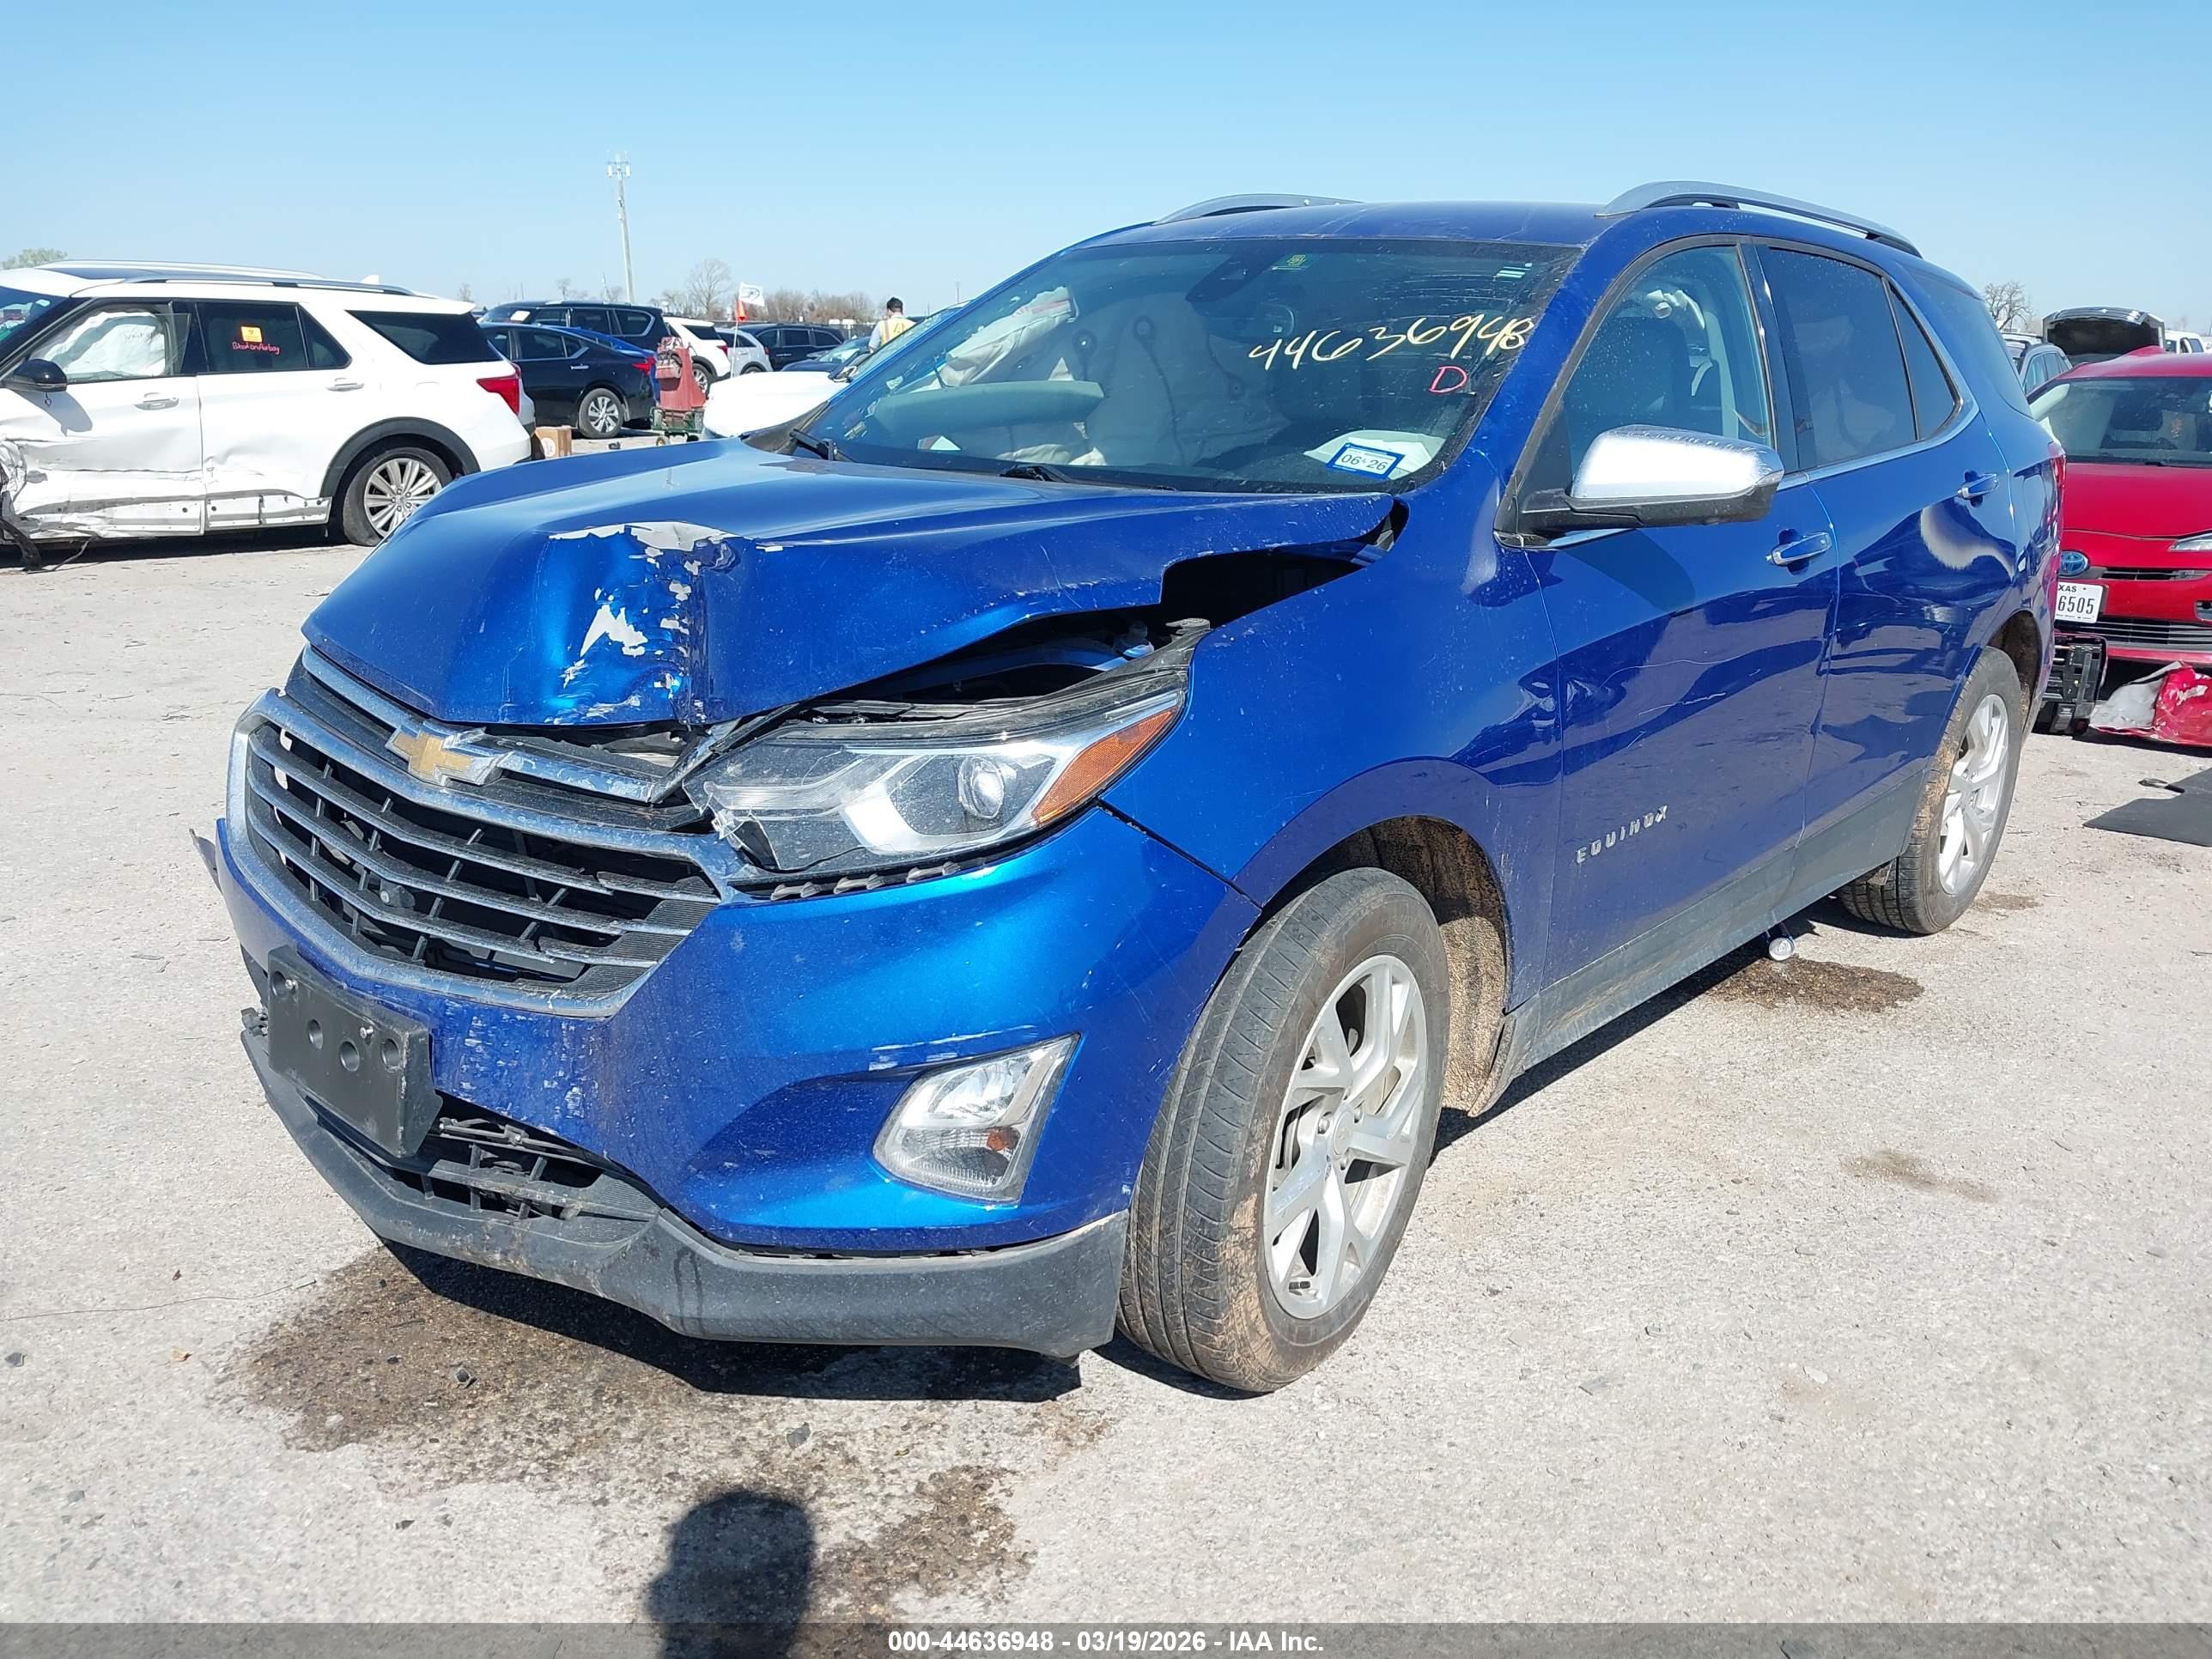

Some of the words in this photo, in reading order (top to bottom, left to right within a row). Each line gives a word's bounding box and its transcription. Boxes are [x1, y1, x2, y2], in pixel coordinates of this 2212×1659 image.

[1248, 313, 1534, 371] 44636948
[1428, 365, 1468, 394] D
[2058, 584, 2077, 592] XAS
[2057, 595, 2095, 615] 6505
[1576, 805, 1668, 864] EQUINOX
